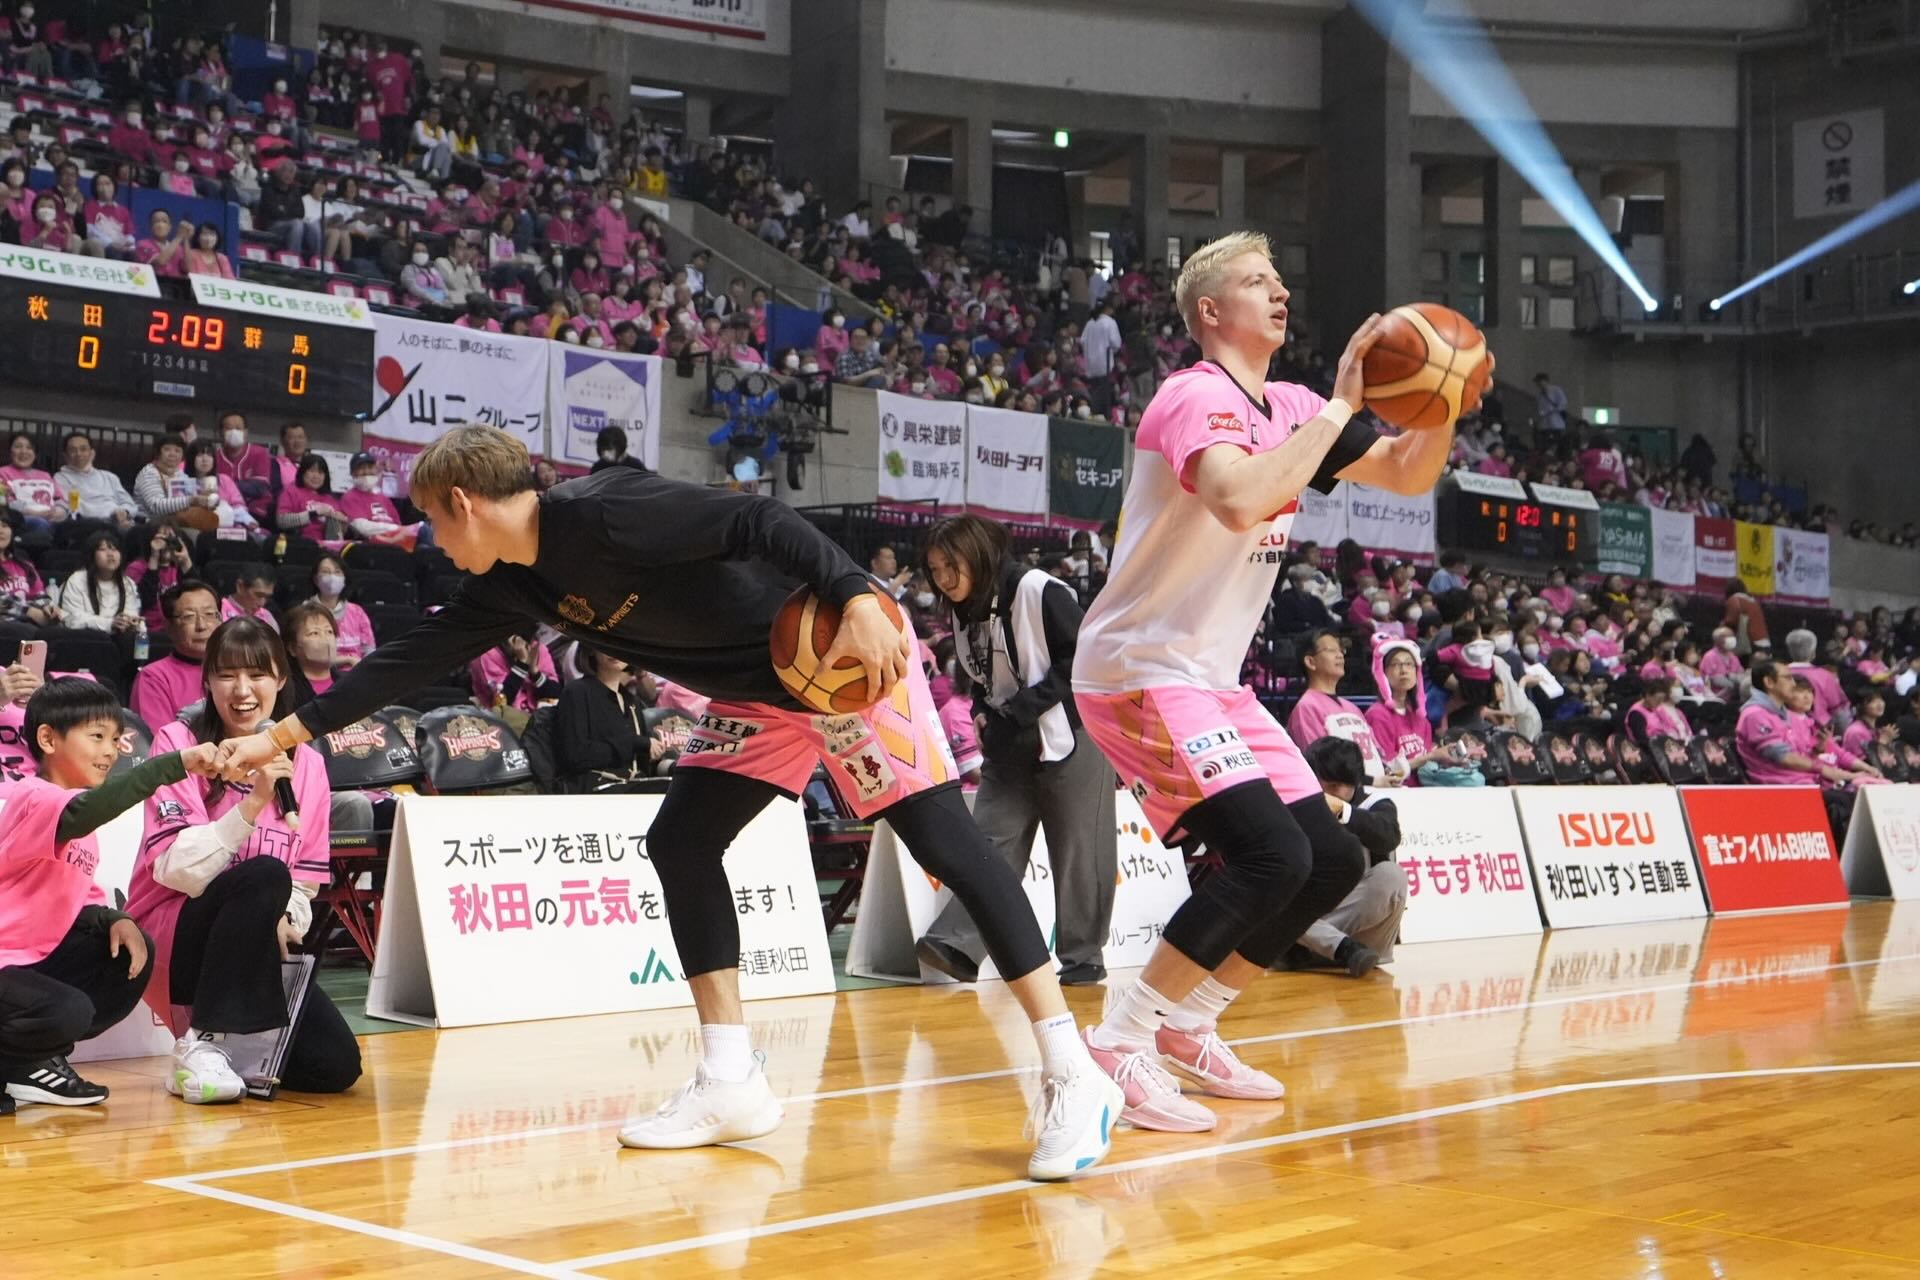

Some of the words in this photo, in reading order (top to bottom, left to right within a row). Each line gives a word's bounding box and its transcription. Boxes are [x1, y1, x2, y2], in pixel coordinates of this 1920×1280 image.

[77, 336, 99, 369] 0
[287, 363, 307, 395] 0
[573, 411, 605, 428] NEXT
[1075, 466, 1123, 488] セキュア
[325, 726, 385, 758] HAPPINETS
[439, 725, 504, 757] HAPPINETS
[1557, 811, 1657, 848] ISUZU
[442, 832, 649, 869] スポーツを通じて
